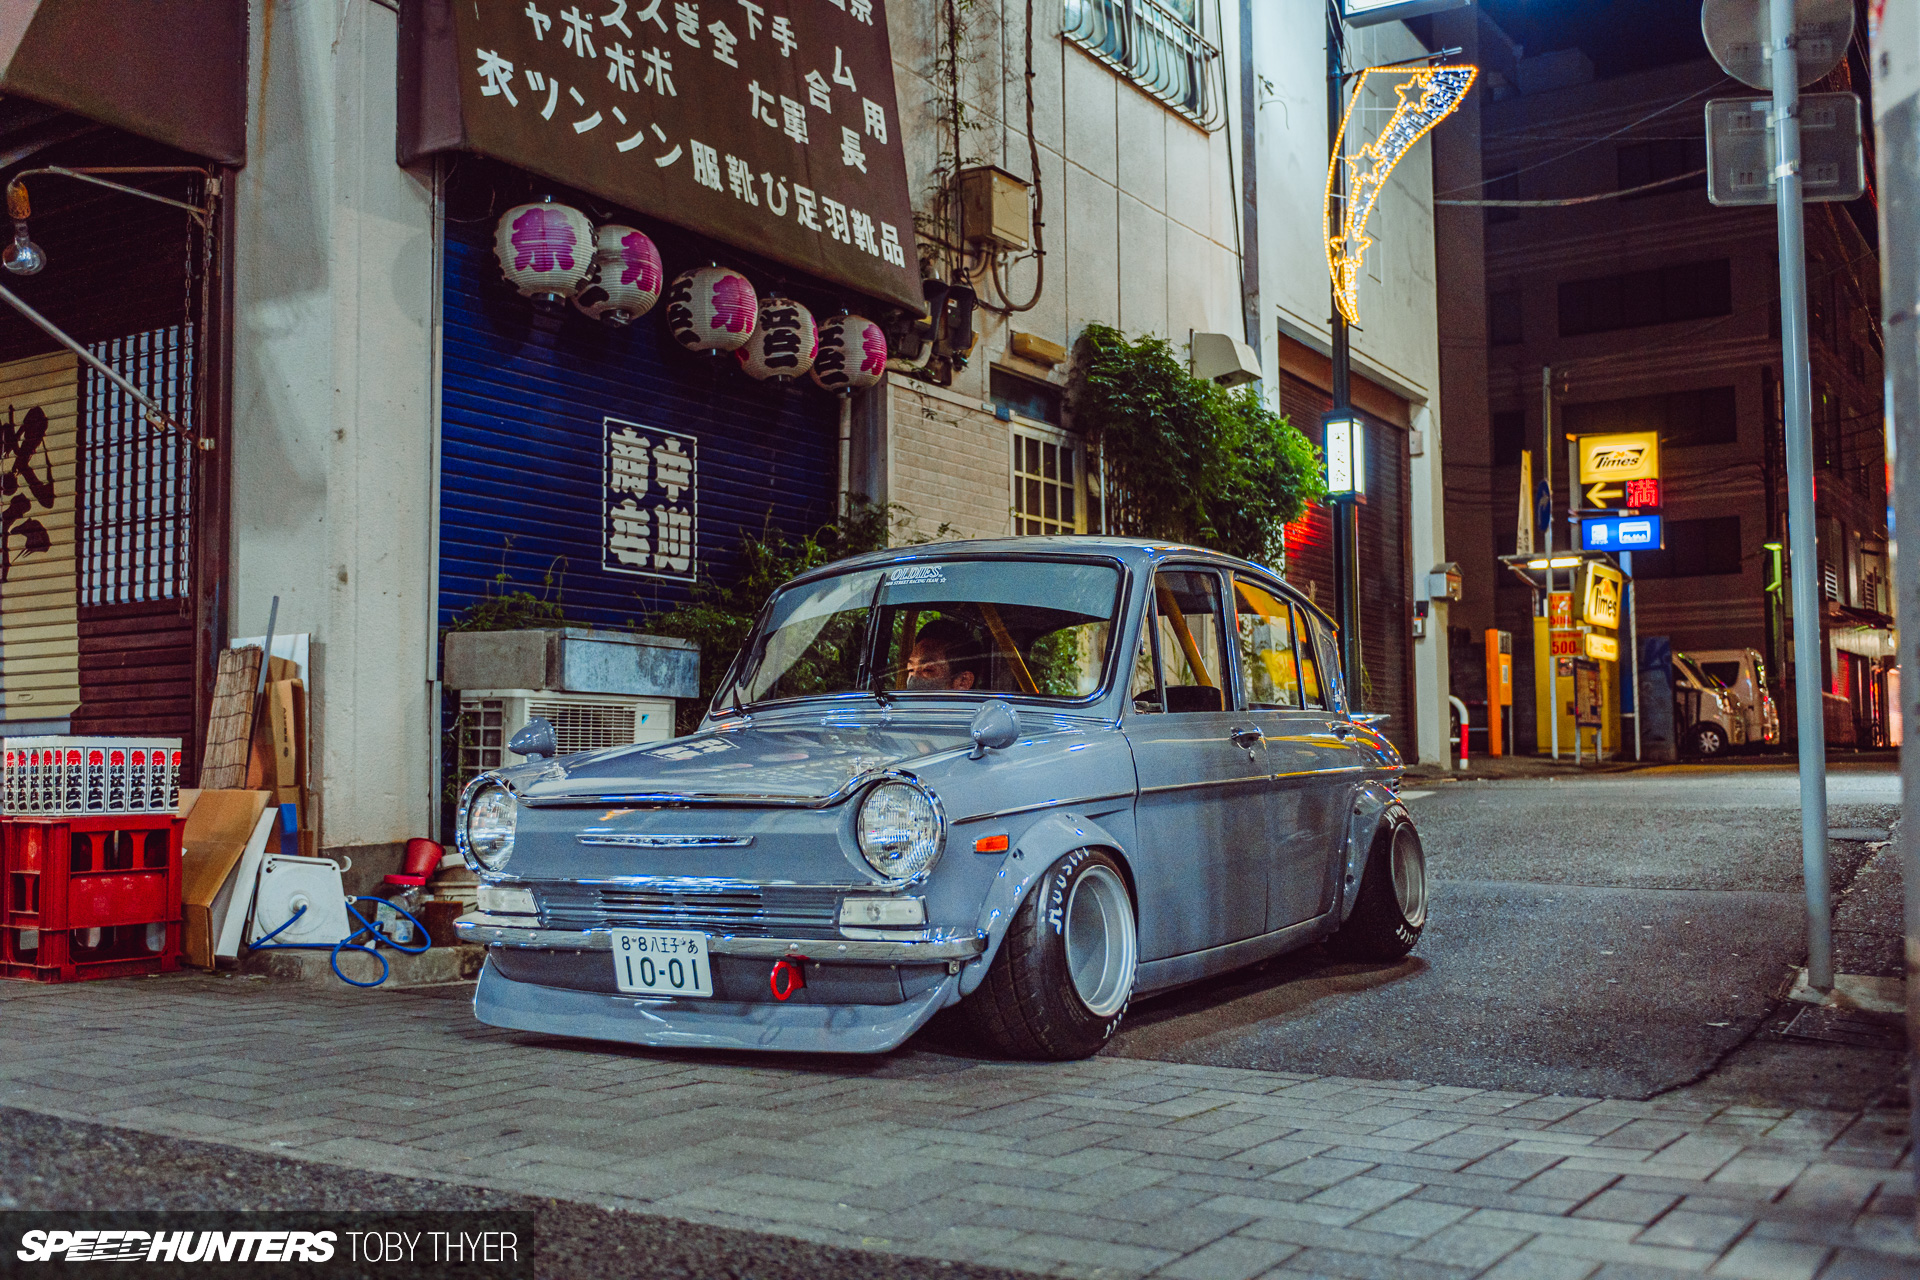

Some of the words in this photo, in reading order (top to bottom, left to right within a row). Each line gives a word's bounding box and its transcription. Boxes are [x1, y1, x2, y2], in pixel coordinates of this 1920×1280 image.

[511, 207, 577, 272] 祭
[711, 274, 758, 334] 祭
[1593, 448, 1645, 470] Times
[1626, 478, 1659, 508] 満
[890, 565, 942, 581] OLDIES
[1594, 575, 1618, 618] Times
[1551, 640, 1577, 655] 500
[650, 936, 680, 953] 八王子
[687, 938, 699, 955] あ
[625, 955, 700, 990] 10-01
